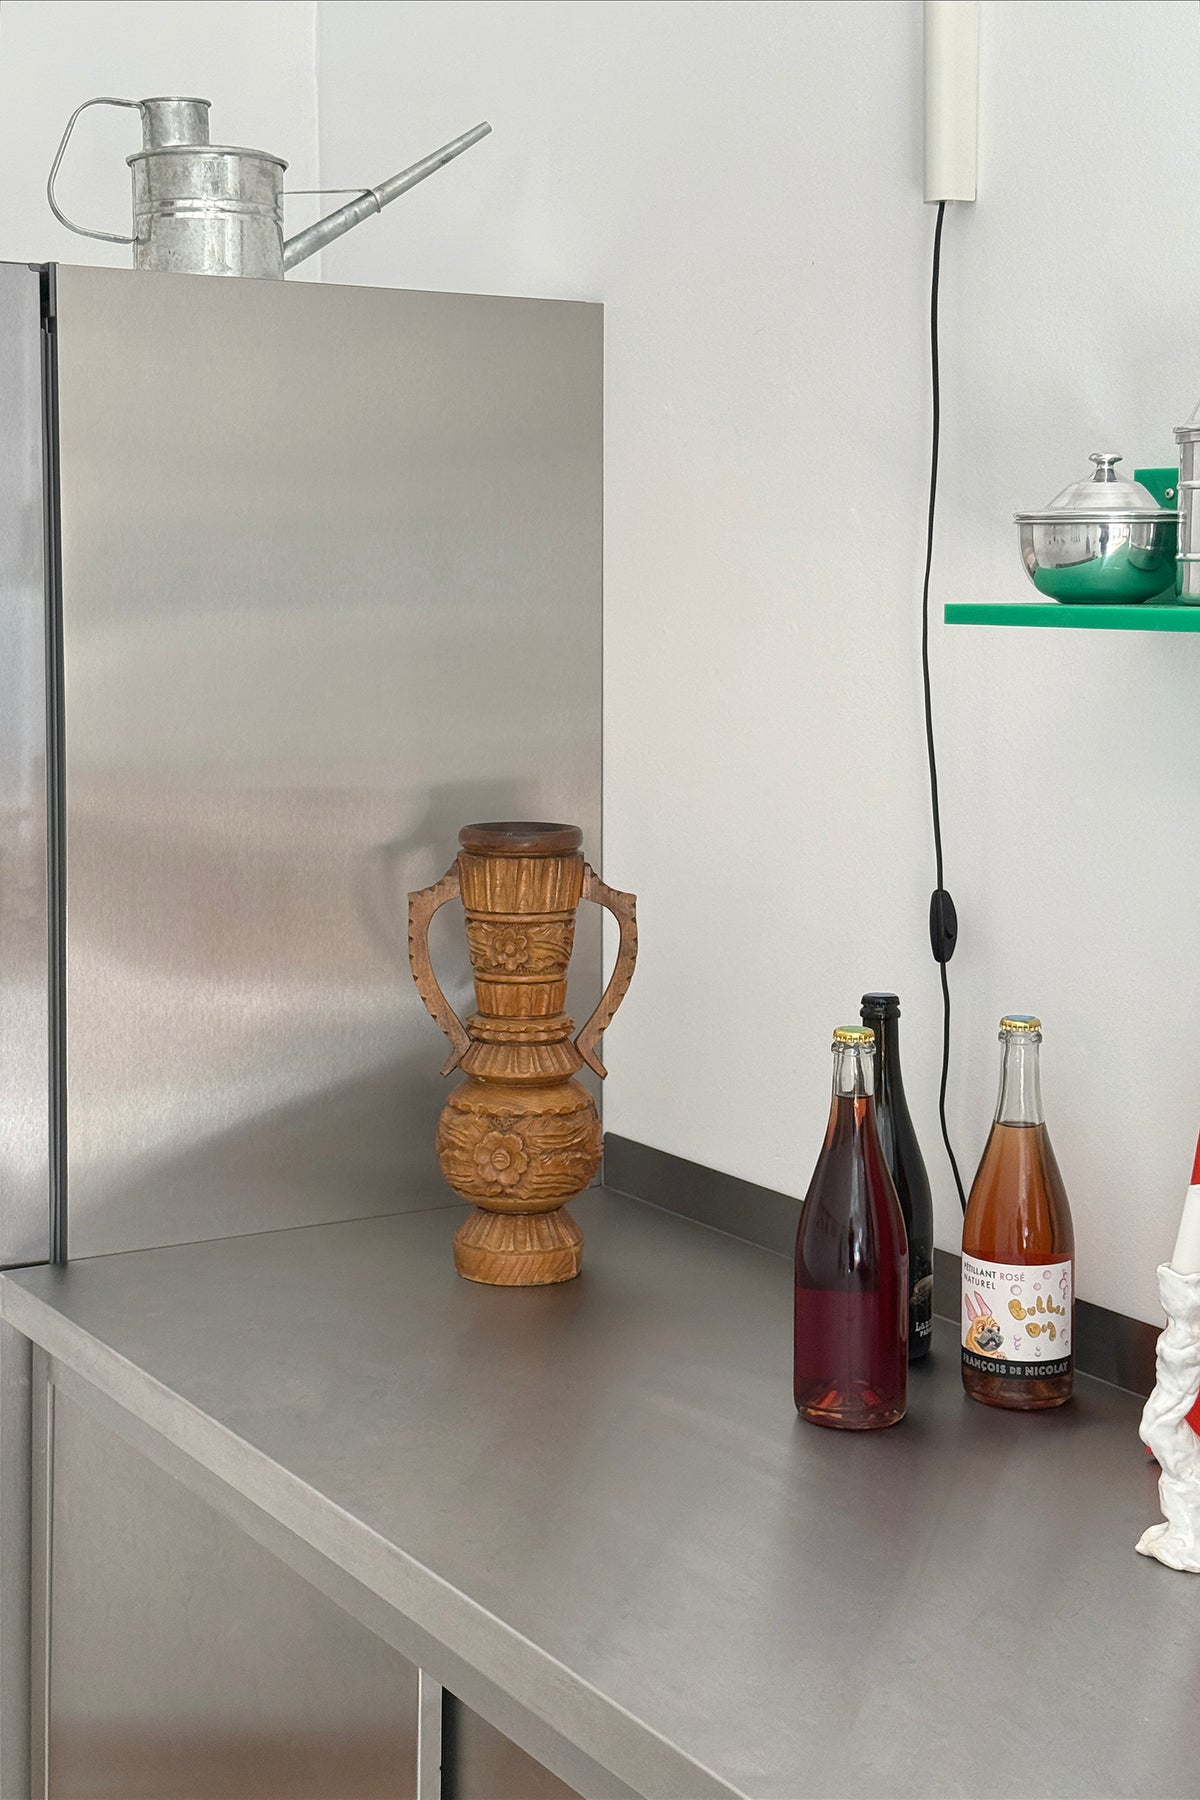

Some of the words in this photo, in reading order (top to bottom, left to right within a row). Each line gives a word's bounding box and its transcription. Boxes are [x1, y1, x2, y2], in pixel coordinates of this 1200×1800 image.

[964, 1273, 996, 1290] NATUREL
[1000, 1272, 1025, 1282] ROSÉ
[963, 1352, 1007, 1374] FRANÇOIS
[1009, 1366, 1022, 1375] DE
[1025, 1362, 1068, 1376] NICOLAY
